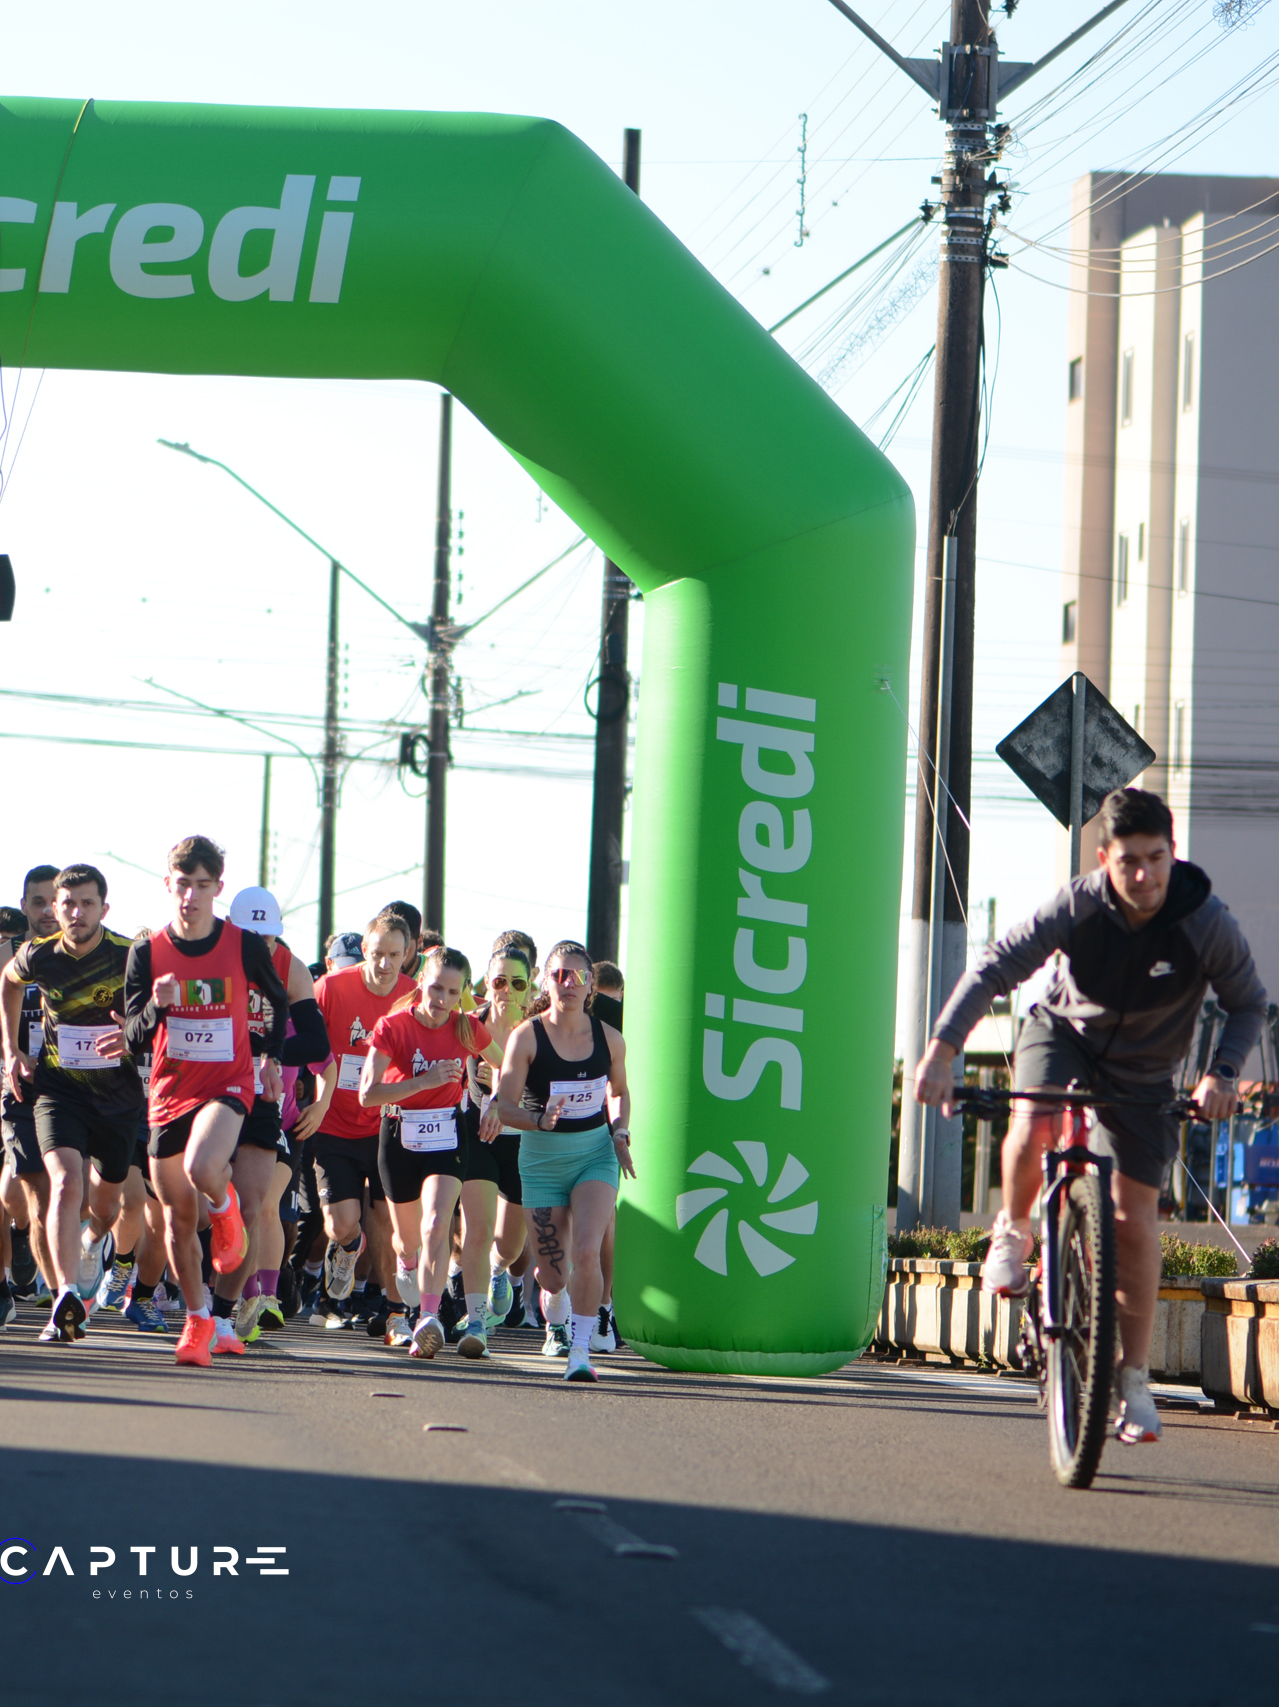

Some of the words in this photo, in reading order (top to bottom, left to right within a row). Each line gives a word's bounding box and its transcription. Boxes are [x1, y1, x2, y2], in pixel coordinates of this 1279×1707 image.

[702, 682, 817, 1112] Sicredi
[184, 1032, 214, 1043] 072
[568, 1092, 592, 1103] 125
[418, 1123, 441, 1134] 201
